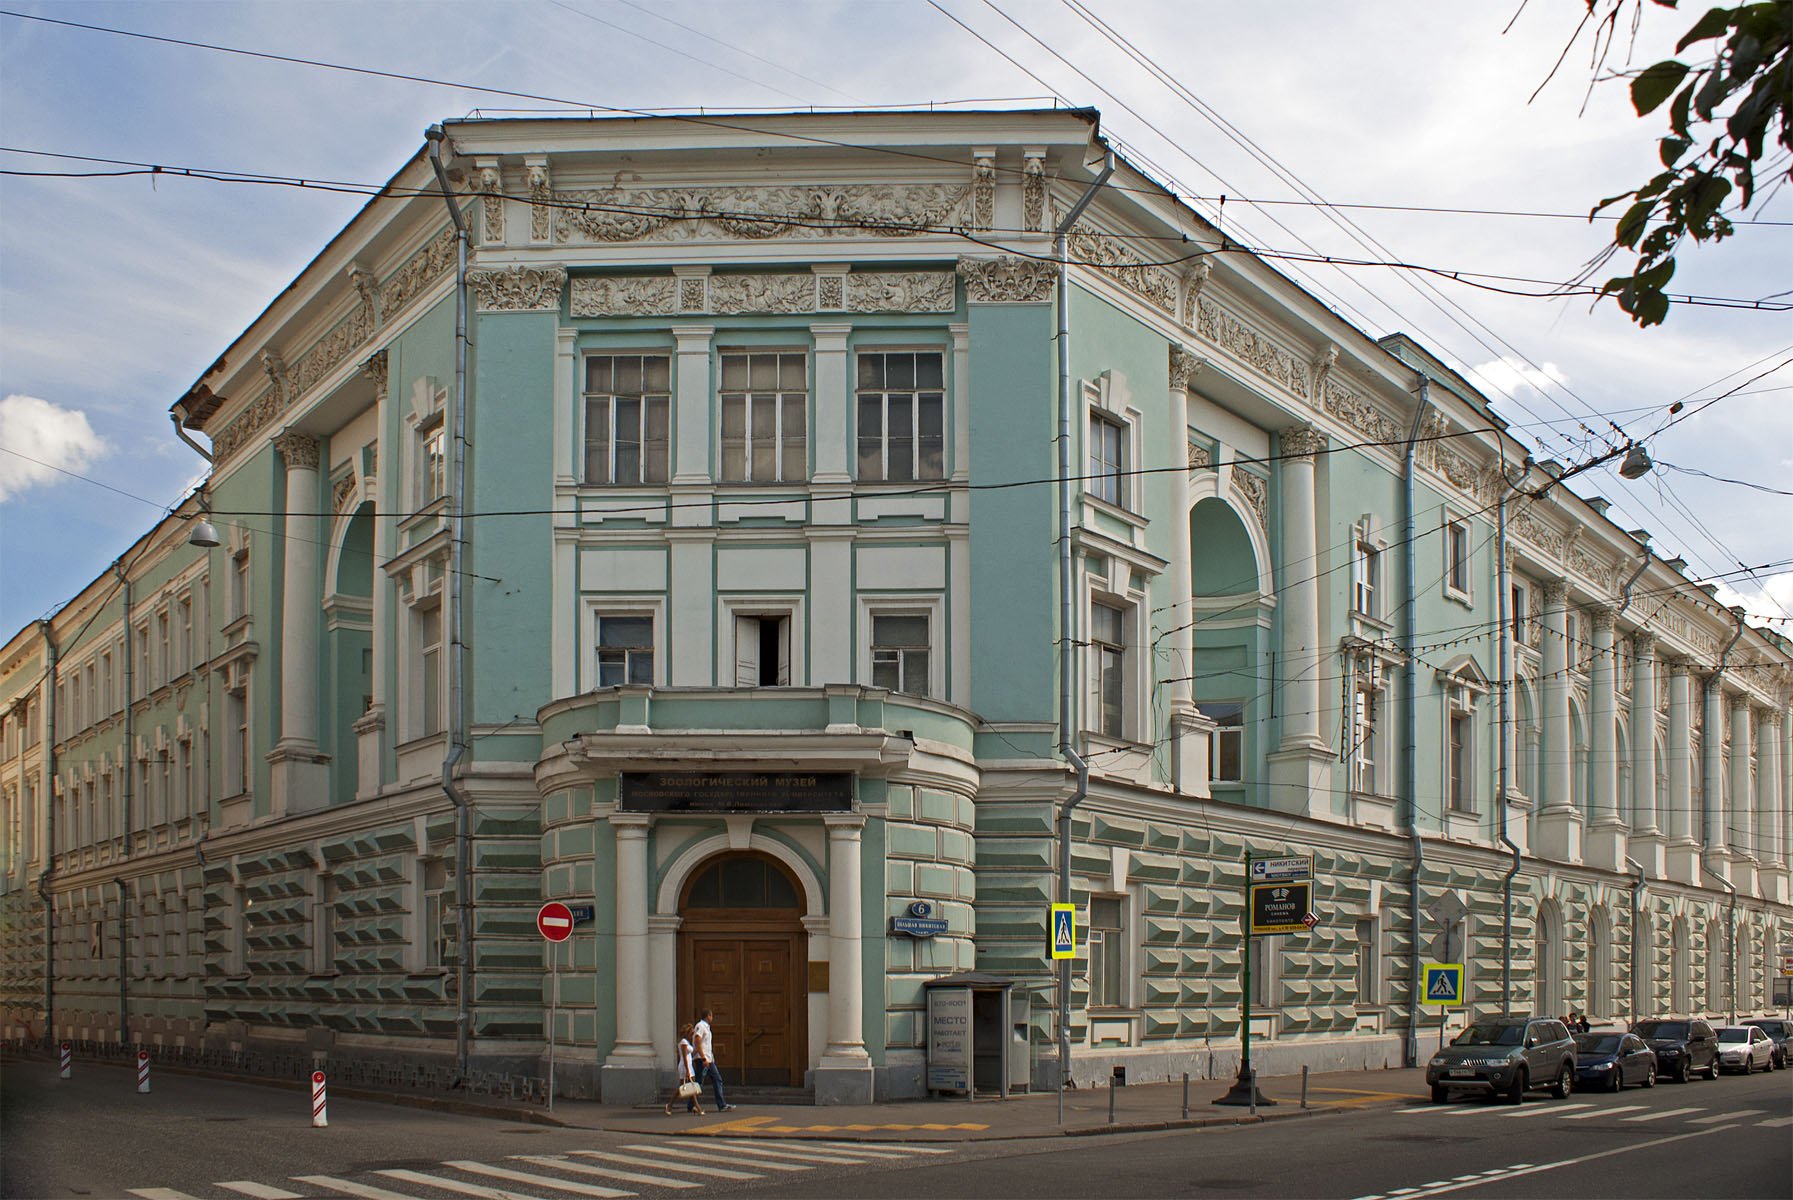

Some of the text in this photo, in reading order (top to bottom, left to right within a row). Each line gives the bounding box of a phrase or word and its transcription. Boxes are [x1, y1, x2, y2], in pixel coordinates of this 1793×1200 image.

[659, 776, 817, 787] ЗООЛОГИЧЕСКИЙ МУЗЕЙ
[1270, 859, 1309, 867] НИКИТСКИЙ
[918, 904, 925, 914] 6
[1264, 902, 1296, 911] РОМАНОВ
[934, 1016, 967, 1025] МЕСТО
